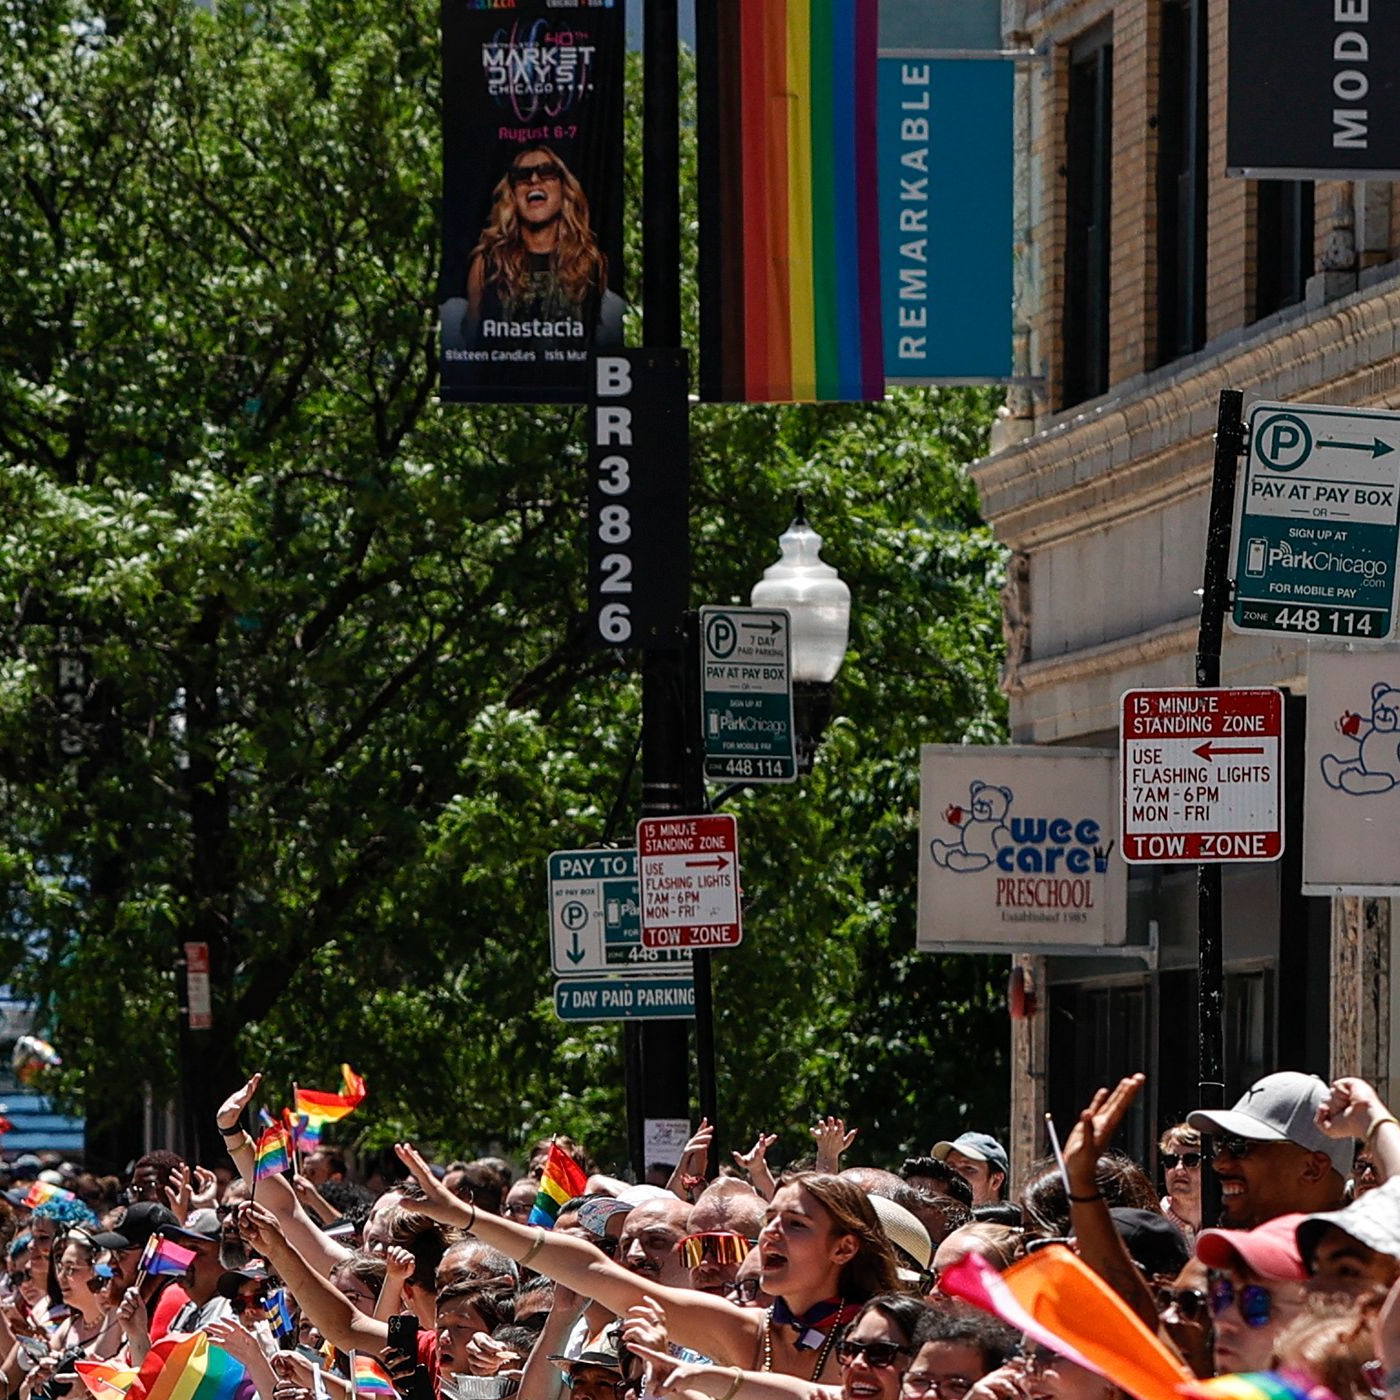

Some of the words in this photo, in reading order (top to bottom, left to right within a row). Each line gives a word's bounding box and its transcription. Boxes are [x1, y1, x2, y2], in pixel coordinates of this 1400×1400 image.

[482, 46, 596, 67] MARKET
[488, 65, 575, 85] DAYS
[488, 83, 553, 95] CHICAGO
[499, 126, 548, 143] August
[898, 64, 930, 359] REMARKABLE
[483, 317, 584, 337] Anastacia
[445, 349, 488, 361] Sixteen
[491, 349, 536, 361] Candles
[1251, 482, 1285, 498] PAY
[1288, 485, 1311, 499] AT
[1315, 487, 1350, 504] PAY
[1354, 490, 1393, 507] BOX
[1313, 508, 1328, 517] OR
[1289, 528, 1315, 539] SIGN
[1317, 529, 1332, 540] UP
[1334, 531, 1349, 541] AT
[1268, 548, 1387, 577] ParkChicago
[1269, 583, 1291, 594] FOR
[1294, 584, 1335, 597] MOBILE
[1337, 587, 1357, 598] PAY
[1360, 578, 1385, 588] .com
[1243, 611, 1269, 622] ZONE
[1275, 607, 1320, 631] 448
[1329, 611, 1372, 635] 114
[758, 636, 777, 646] DAY
[707, 666, 724, 679] PAY
[727, 667, 740, 679] AT
[742, 667, 761, 680] PAY
[763, 668, 785, 680] BOX
[1134, 698, 1149, 714] 15
[1159, 697, 1219, 713] MINUTE
[720, 715, 786, 736] ParkChicago
[1133, 717, 1212, 734] STANDING
[1222, 715, 1265, 732] ZONE
[1133, 748, 1162, 764] USE
[726, 759, 753, 776] 448
[757, 760, 783, 776] 114
[1132, 767, 1208, 784] FLASHING
[1217, 766, 1270, 783] LIGHTS
[645, 825, 655, 837] 15
[660, 822, 698, 836] MINUTE
[1010, 818, 1100, 844] wee
[645, 838, 694, 852] STANDING
[699, 836, 726, 849] ZONE
[1133, 836, 1185, 857] TOW
[1200, 835, 1266, 856] ZONE
[559, 859, 596, 877] PAY
[600, 858, 626, 875] TO
[996, 846, 1091, 874] care
[645, 863, 664, 876] USE
[646, 877, 693, 890] FLASHING
[698, 874, 731, 888] LIGHTS
[996, 877, 1094, 908] PRESCHOOL
[648, 928, 680, 945] TOW
[690, 926, 731, 943] ZONE
[560, 992, 568, 1008] 7
[573, 990, 598, 1008] DAY
[602, 989, 634, 1006] PAID
[637, 987, 695, 1006] PARKING
